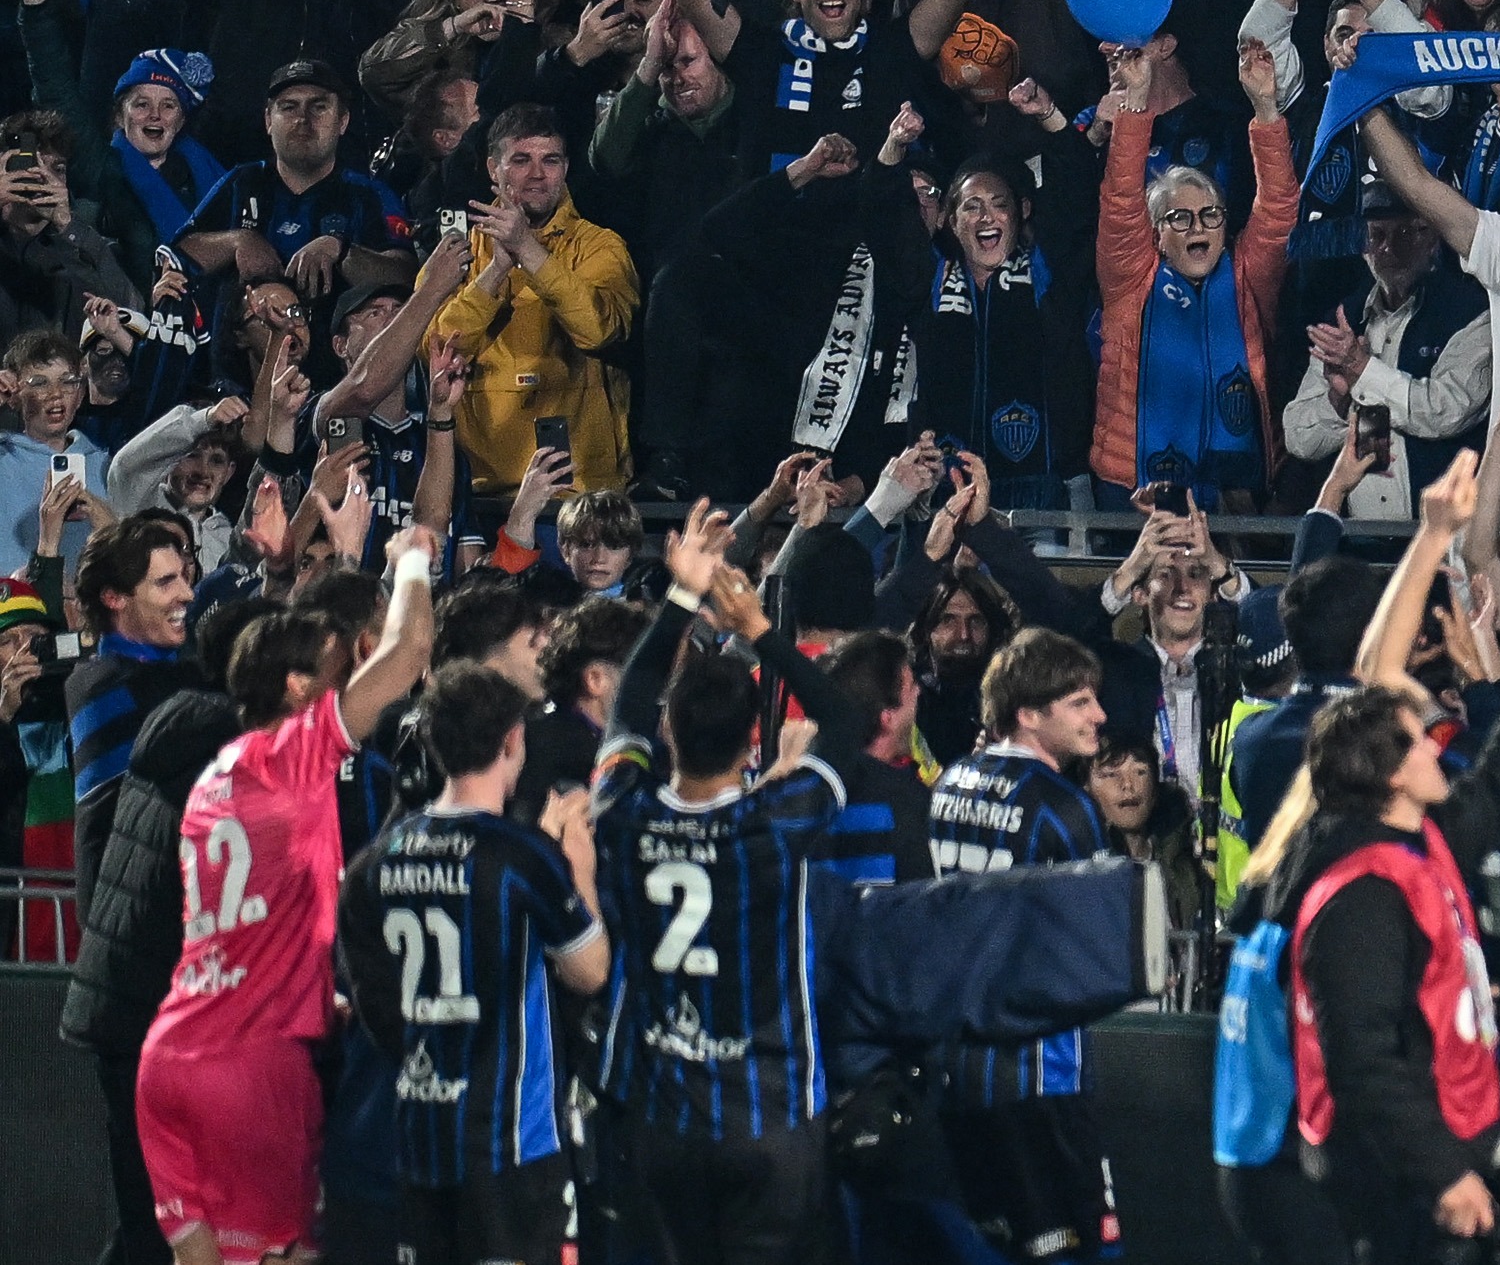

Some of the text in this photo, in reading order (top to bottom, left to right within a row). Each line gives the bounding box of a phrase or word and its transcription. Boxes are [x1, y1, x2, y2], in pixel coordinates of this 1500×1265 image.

[808, 328, 857, 431] ALWAYS
[383, 907, 481, 1023] 21
[645, 861, 719, 975] 2
